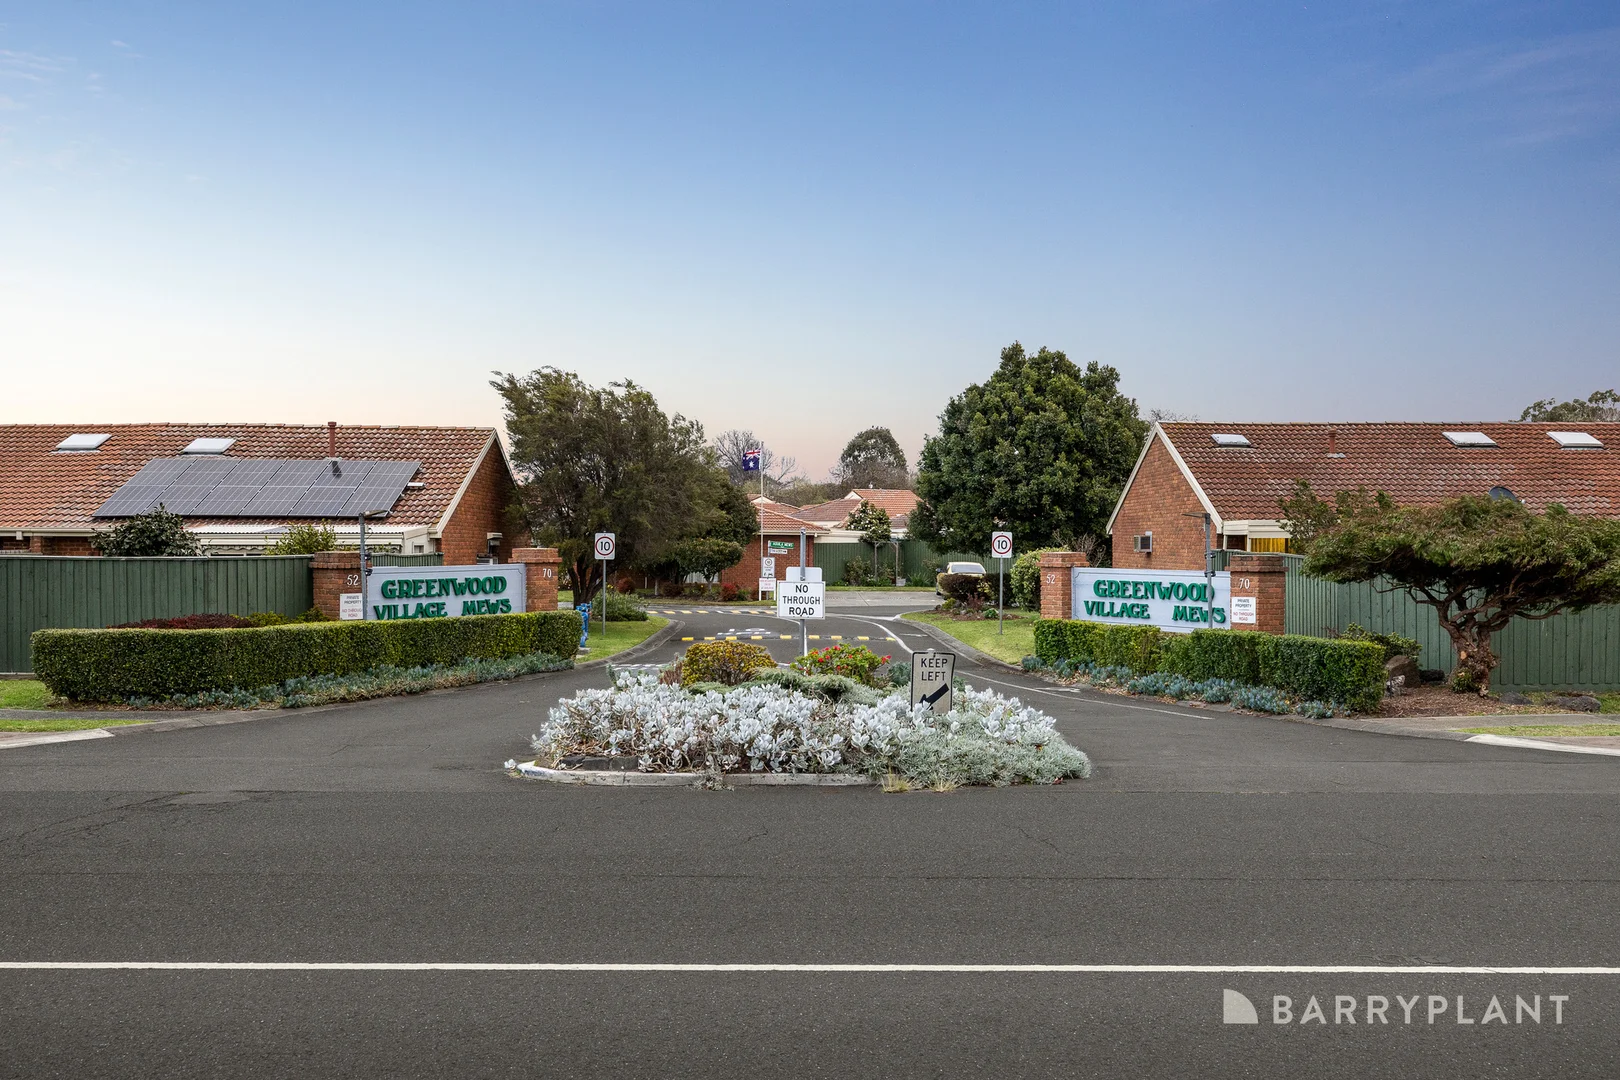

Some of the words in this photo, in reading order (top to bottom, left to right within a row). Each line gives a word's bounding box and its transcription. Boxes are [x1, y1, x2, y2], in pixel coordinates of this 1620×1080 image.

[600, 541, 610, 551] 10
[997, 540, 1008, 550] 10
[542, 568, 552, 578] 70
[346, 574, 360, 586] 52
[1046, 574, 1056, 584] 52
[1240, 578, 1250, 590] 70
[381, 576, 507, 599] GREENWOOD
[796, 584, 808, 593] NO
[1093, 580, 1215, 602] GREENWOOD
[782, 596, 820, 604] THROUGH
[373, 602, 448, 620] VILLAGE
[462, 598, 512, 616] MEWS
[788, 606, 814, 616] ROAD
[1084, 600, 1150, 619] VILLAGE
[1172, 606, 1226, 623] MEWS
[920, 658, 948, 668] KEEP
[922, 672, 946, 681] LEFT
